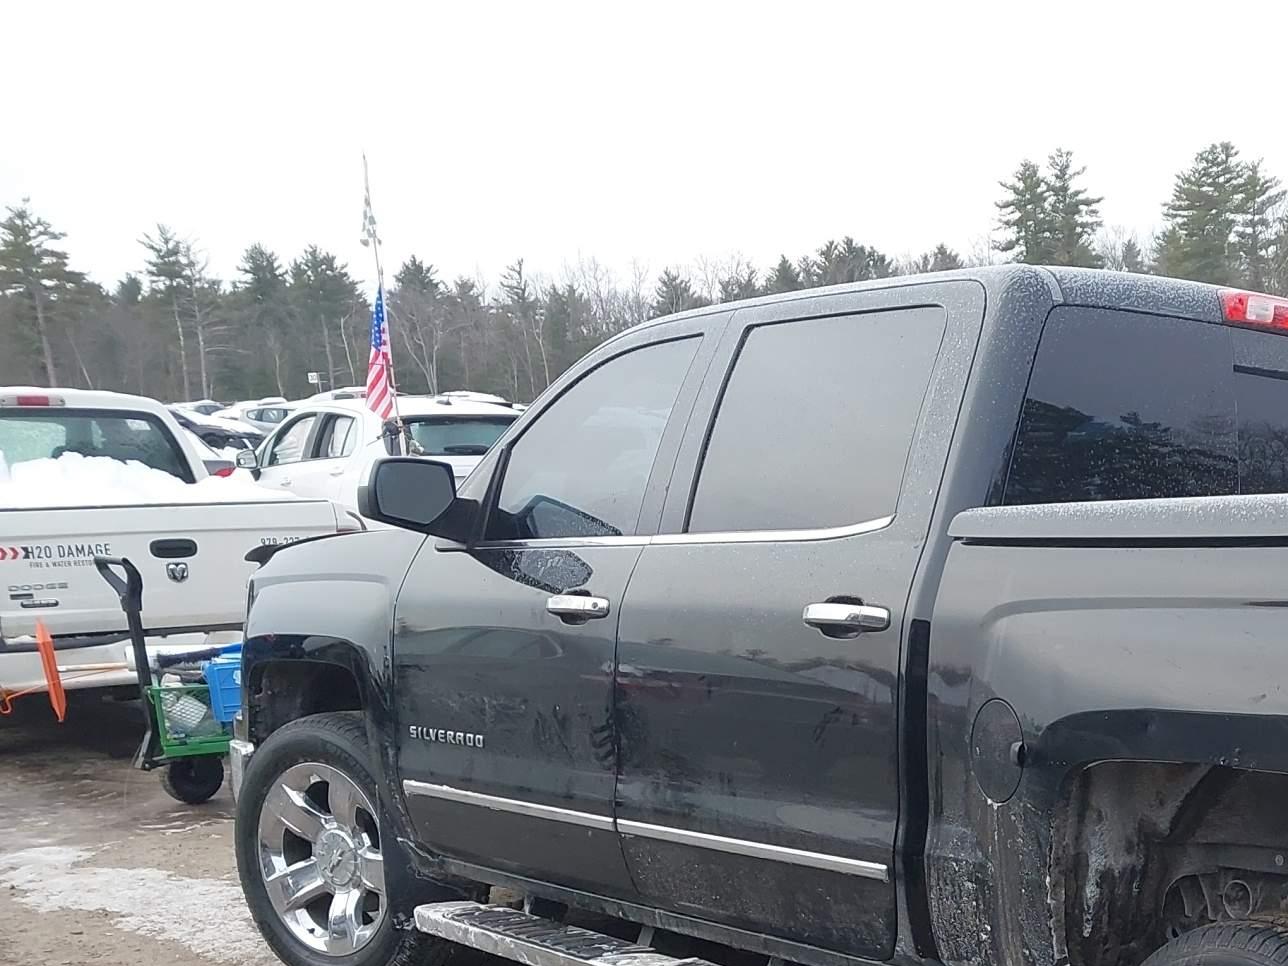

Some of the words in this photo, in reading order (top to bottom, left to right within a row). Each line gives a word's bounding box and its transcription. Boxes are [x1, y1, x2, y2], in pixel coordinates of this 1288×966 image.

[57, 543, 112, 559] DAMAGE
[52, 560, 72, 568] WATER
[8, 582, 69, 592] DODGE
[409, 725, 485, 748] SILVERADO
